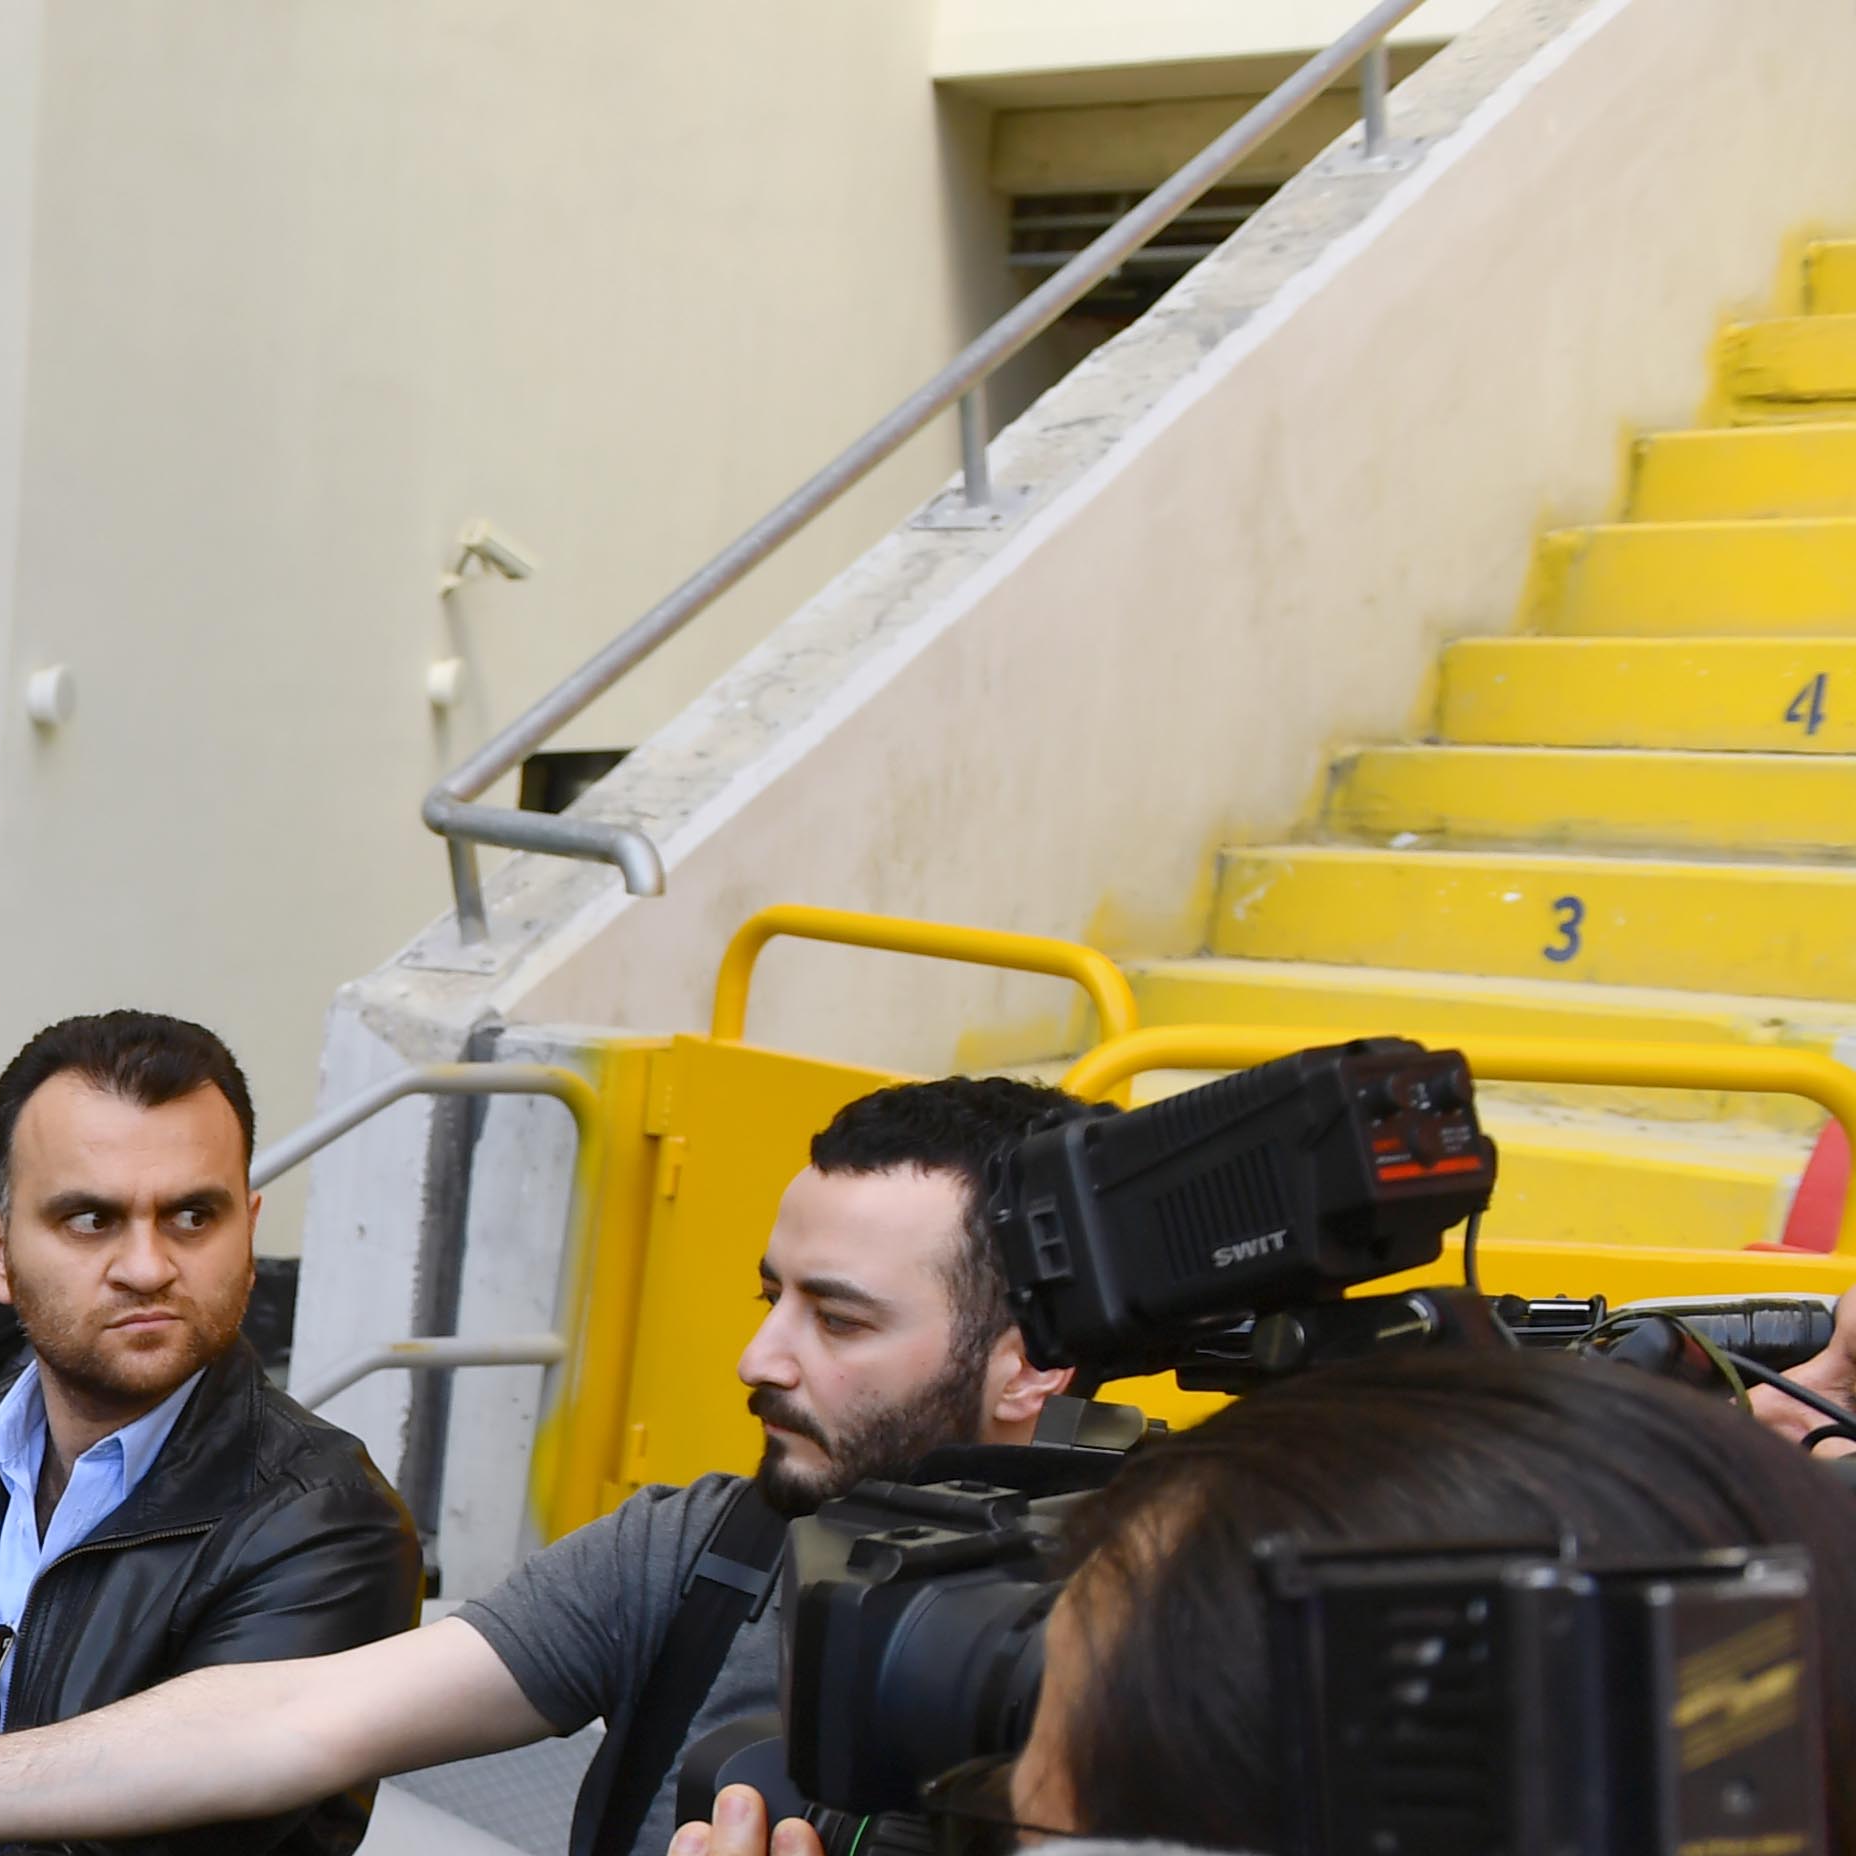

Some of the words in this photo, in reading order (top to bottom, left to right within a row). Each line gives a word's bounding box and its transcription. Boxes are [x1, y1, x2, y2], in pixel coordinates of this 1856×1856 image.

[1784, 671, 1829, 737] 4
[1542, 895, 1585, 963] 3
[1211, 1229, 1287, 1267] SWIT
